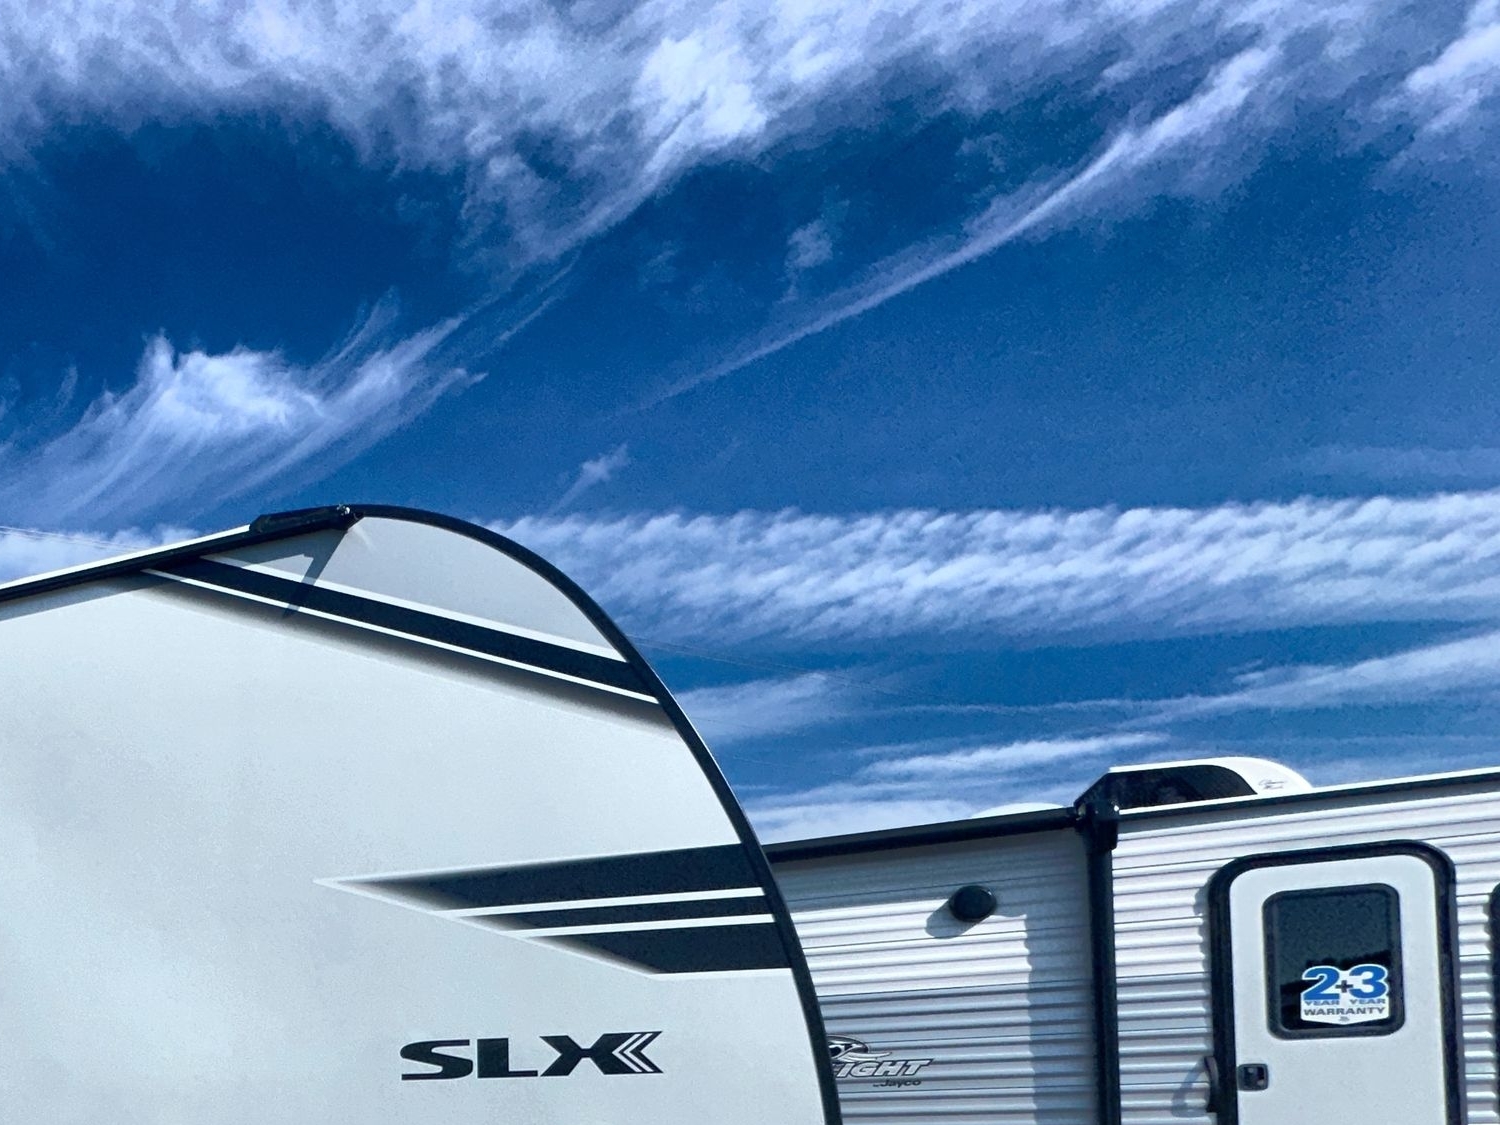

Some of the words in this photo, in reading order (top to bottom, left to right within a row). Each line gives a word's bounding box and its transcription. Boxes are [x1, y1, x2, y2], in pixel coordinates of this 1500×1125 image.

[1303, 1007, 1386, 1016] WARRANTY
[400, 1031, 664, 1081] SLX
[833, 1058, 934, 1078] IGHT
[879, 1079, 922, 1089] Jayco
